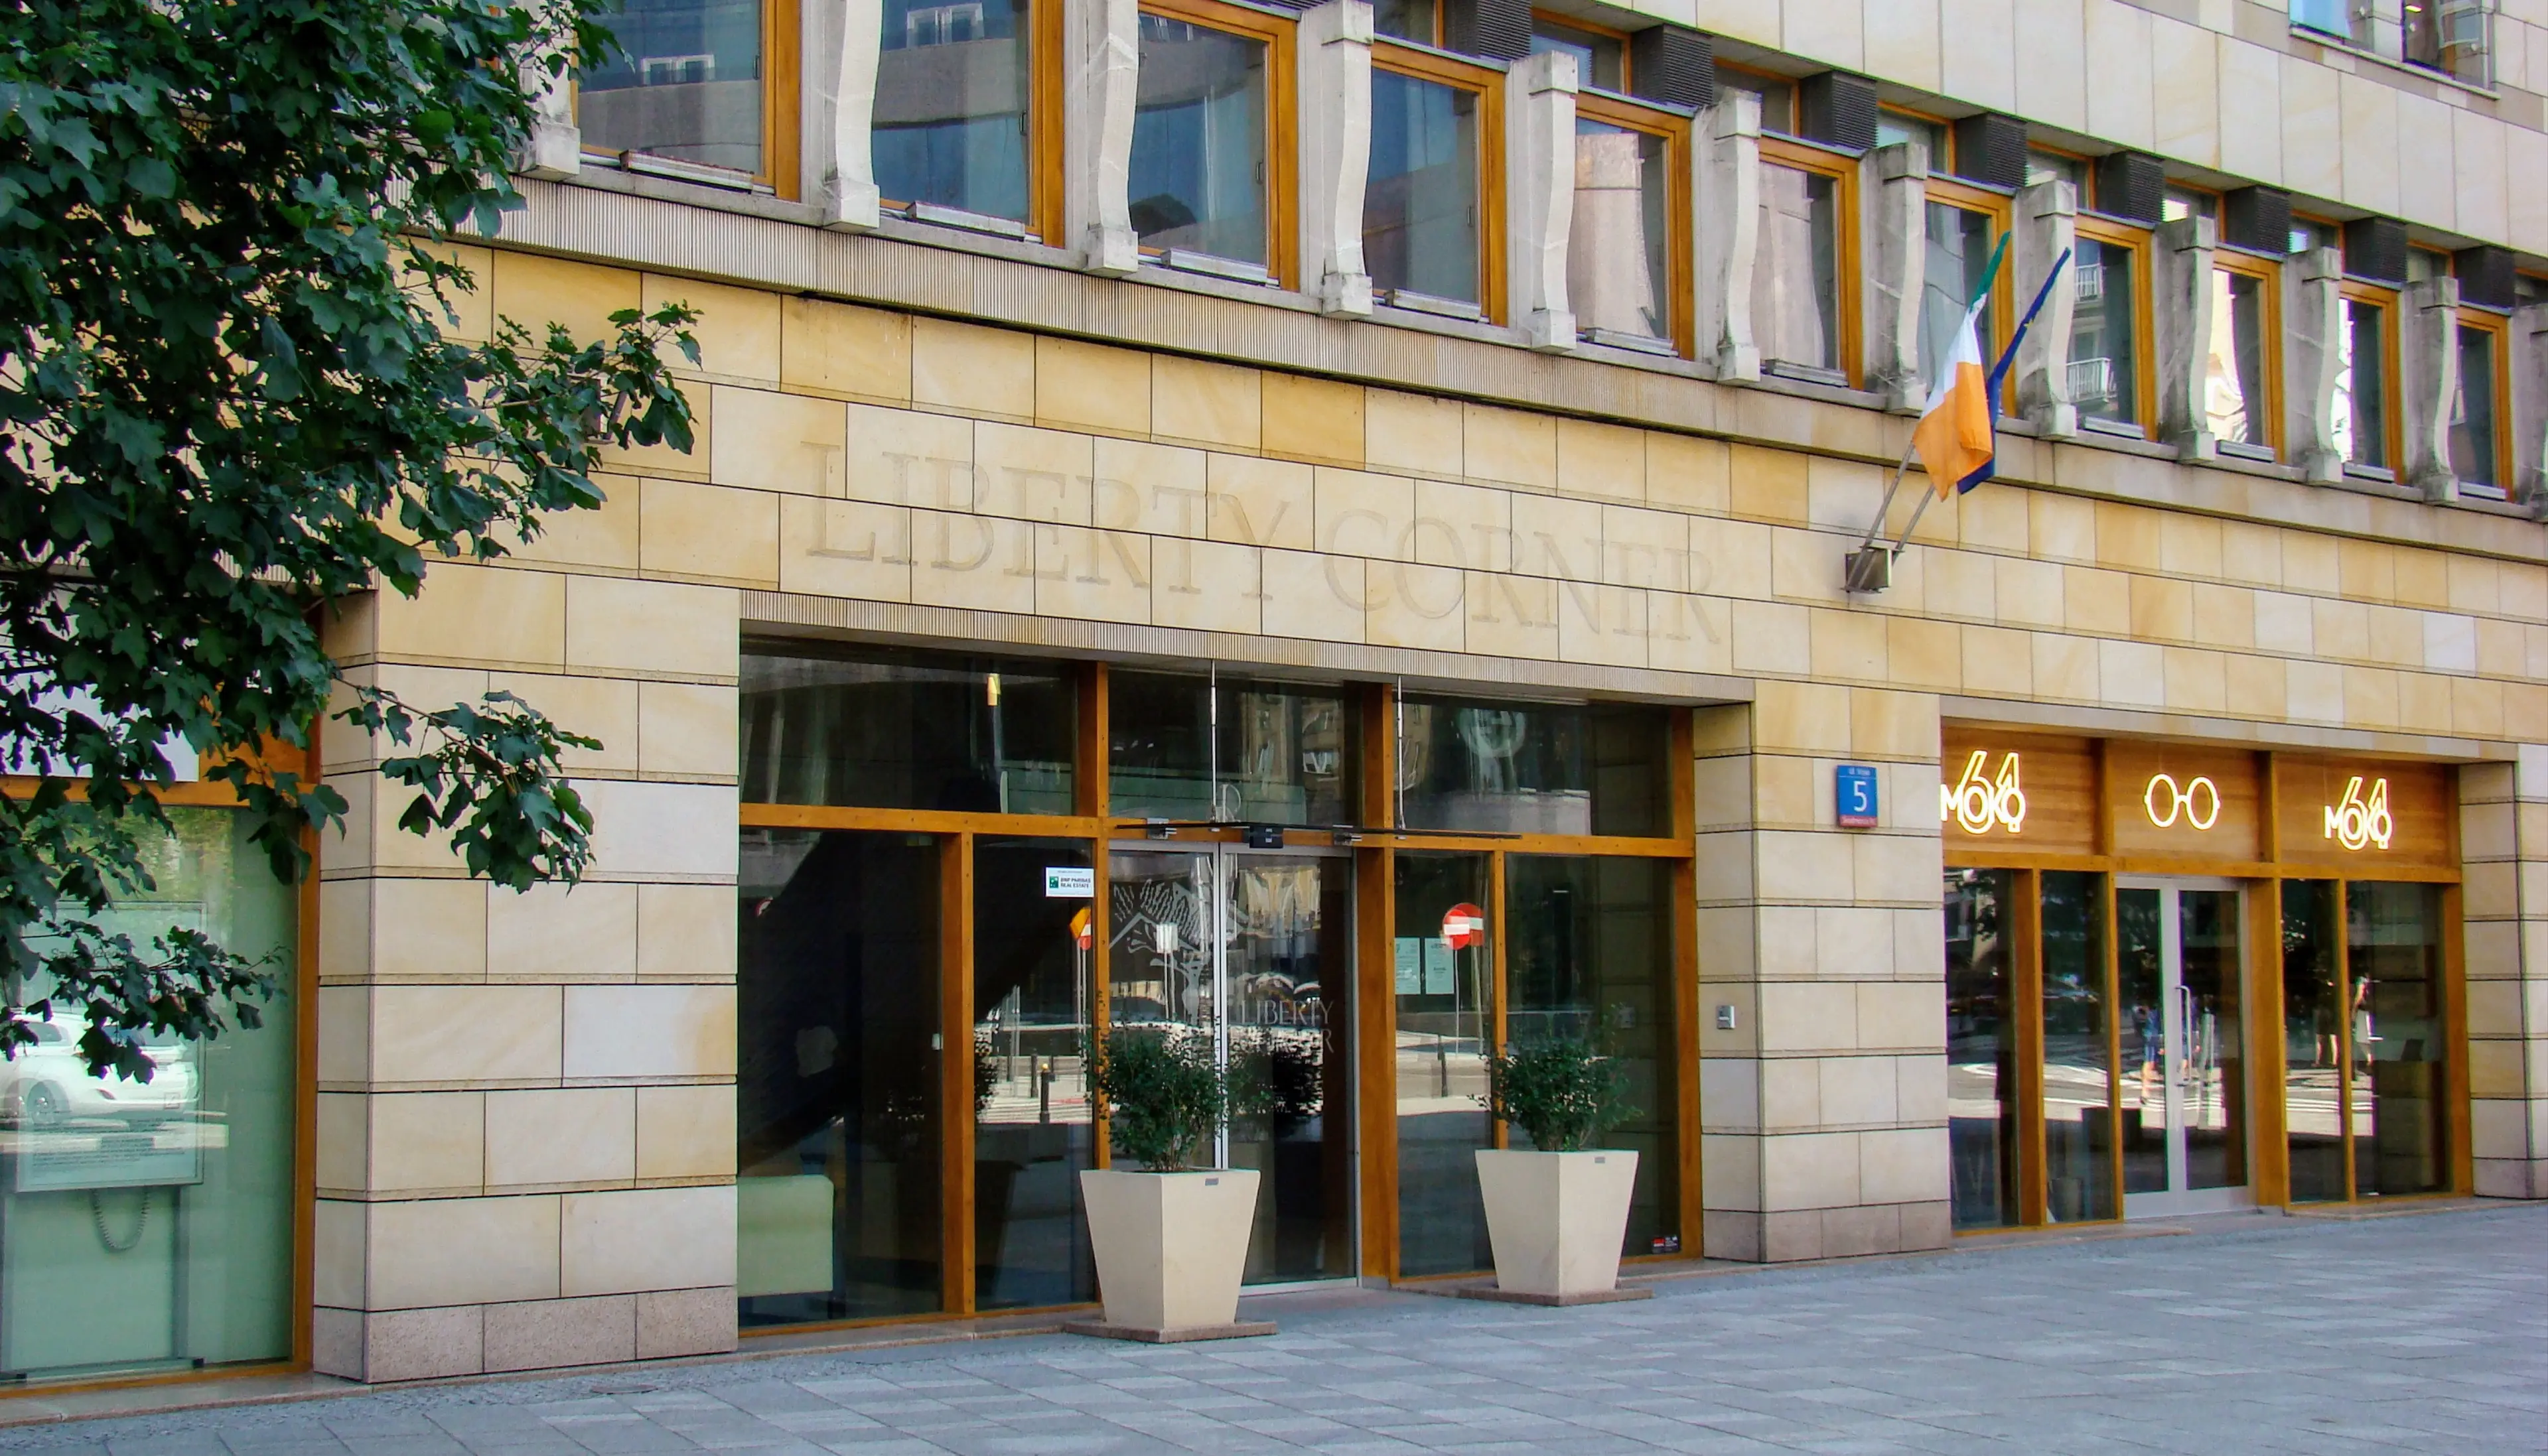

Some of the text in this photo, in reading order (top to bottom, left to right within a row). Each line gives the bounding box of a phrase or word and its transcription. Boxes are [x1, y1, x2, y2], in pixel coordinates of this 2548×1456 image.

[800, 440, 1721, 644] LIBERTY CORNER
[1853, 780, 1867, 812] 5
[1241, 999, 1334, 1027] LIBERTY
